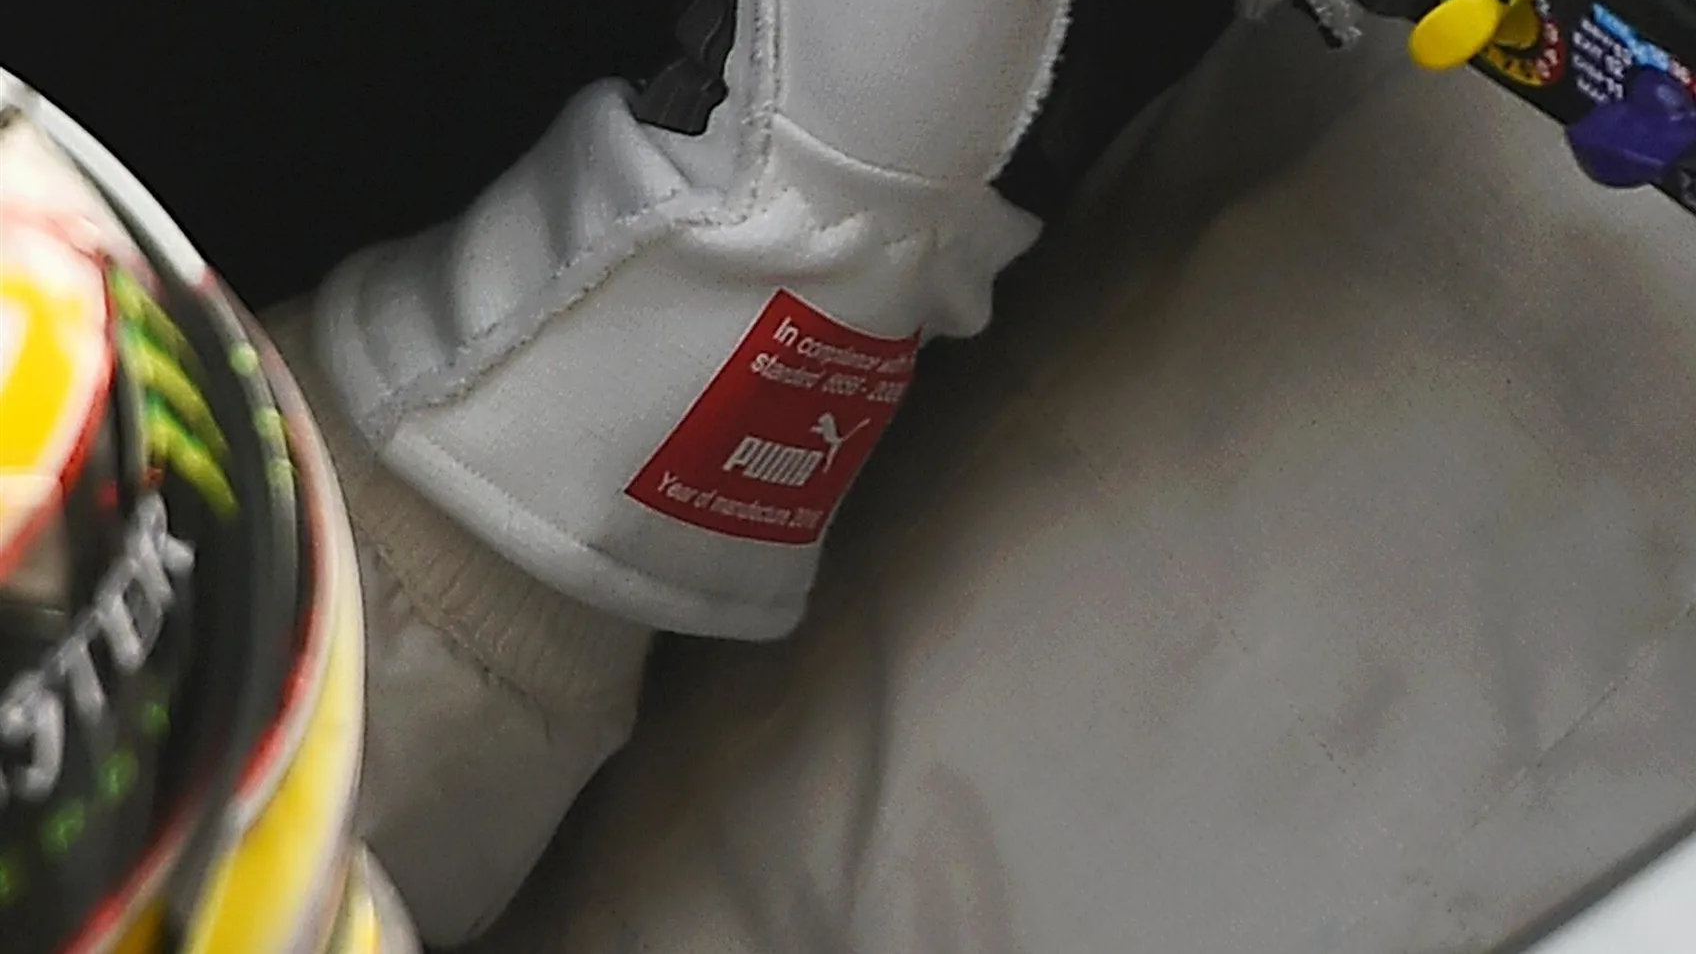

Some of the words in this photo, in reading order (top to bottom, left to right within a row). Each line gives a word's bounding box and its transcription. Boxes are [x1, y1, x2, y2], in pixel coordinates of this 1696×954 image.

[772, 316, 799, 347] In
[751, 352, 827, 389] standard
[721, 435, 824, 487] PUMA
[657, 471, 698, 503] Year
[693, 489, 718, 508] of
